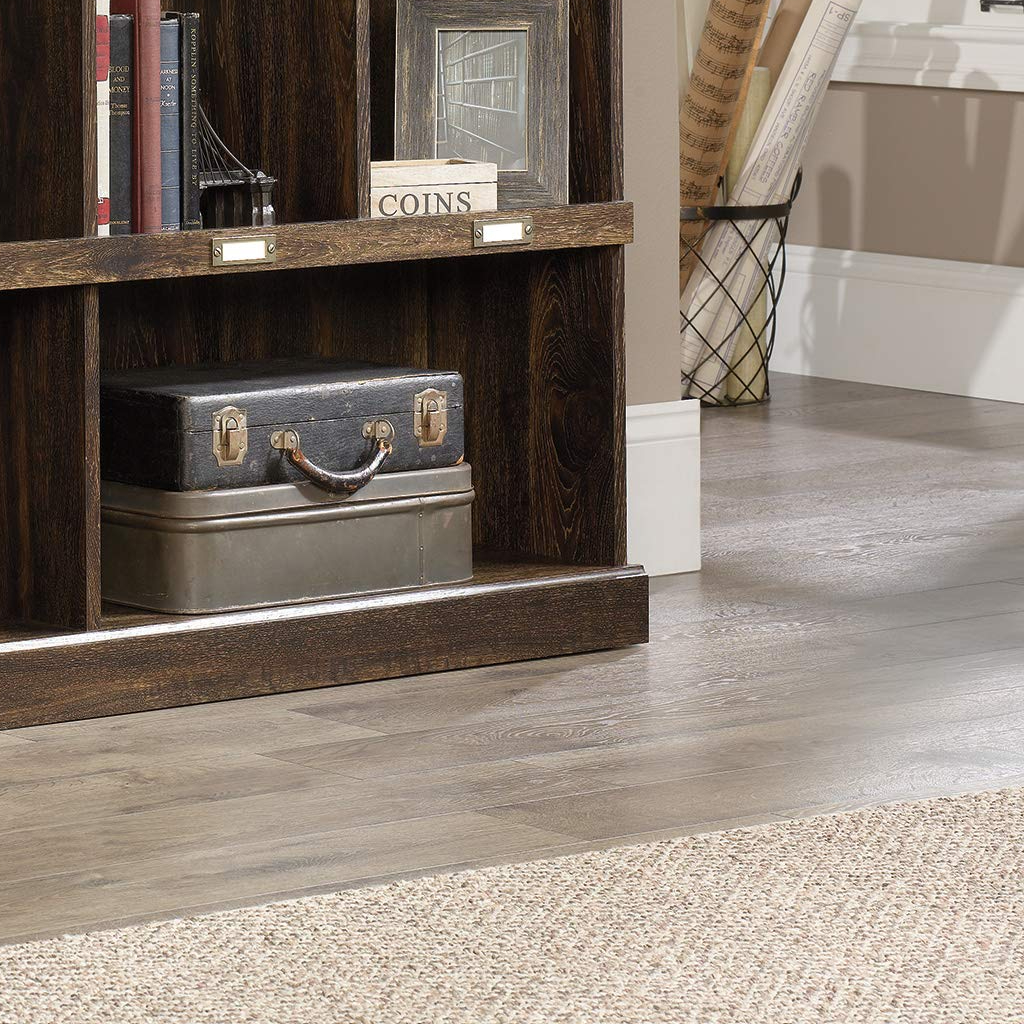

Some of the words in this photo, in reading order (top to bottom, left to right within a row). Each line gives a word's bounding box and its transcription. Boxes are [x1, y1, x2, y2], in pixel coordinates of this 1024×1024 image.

[801, 70, 817, 93] RED
[779, 93, 807, 140] RAMBLER
[190, 130, 197, 145] TO
[378, 191, 472, 216] COINS
